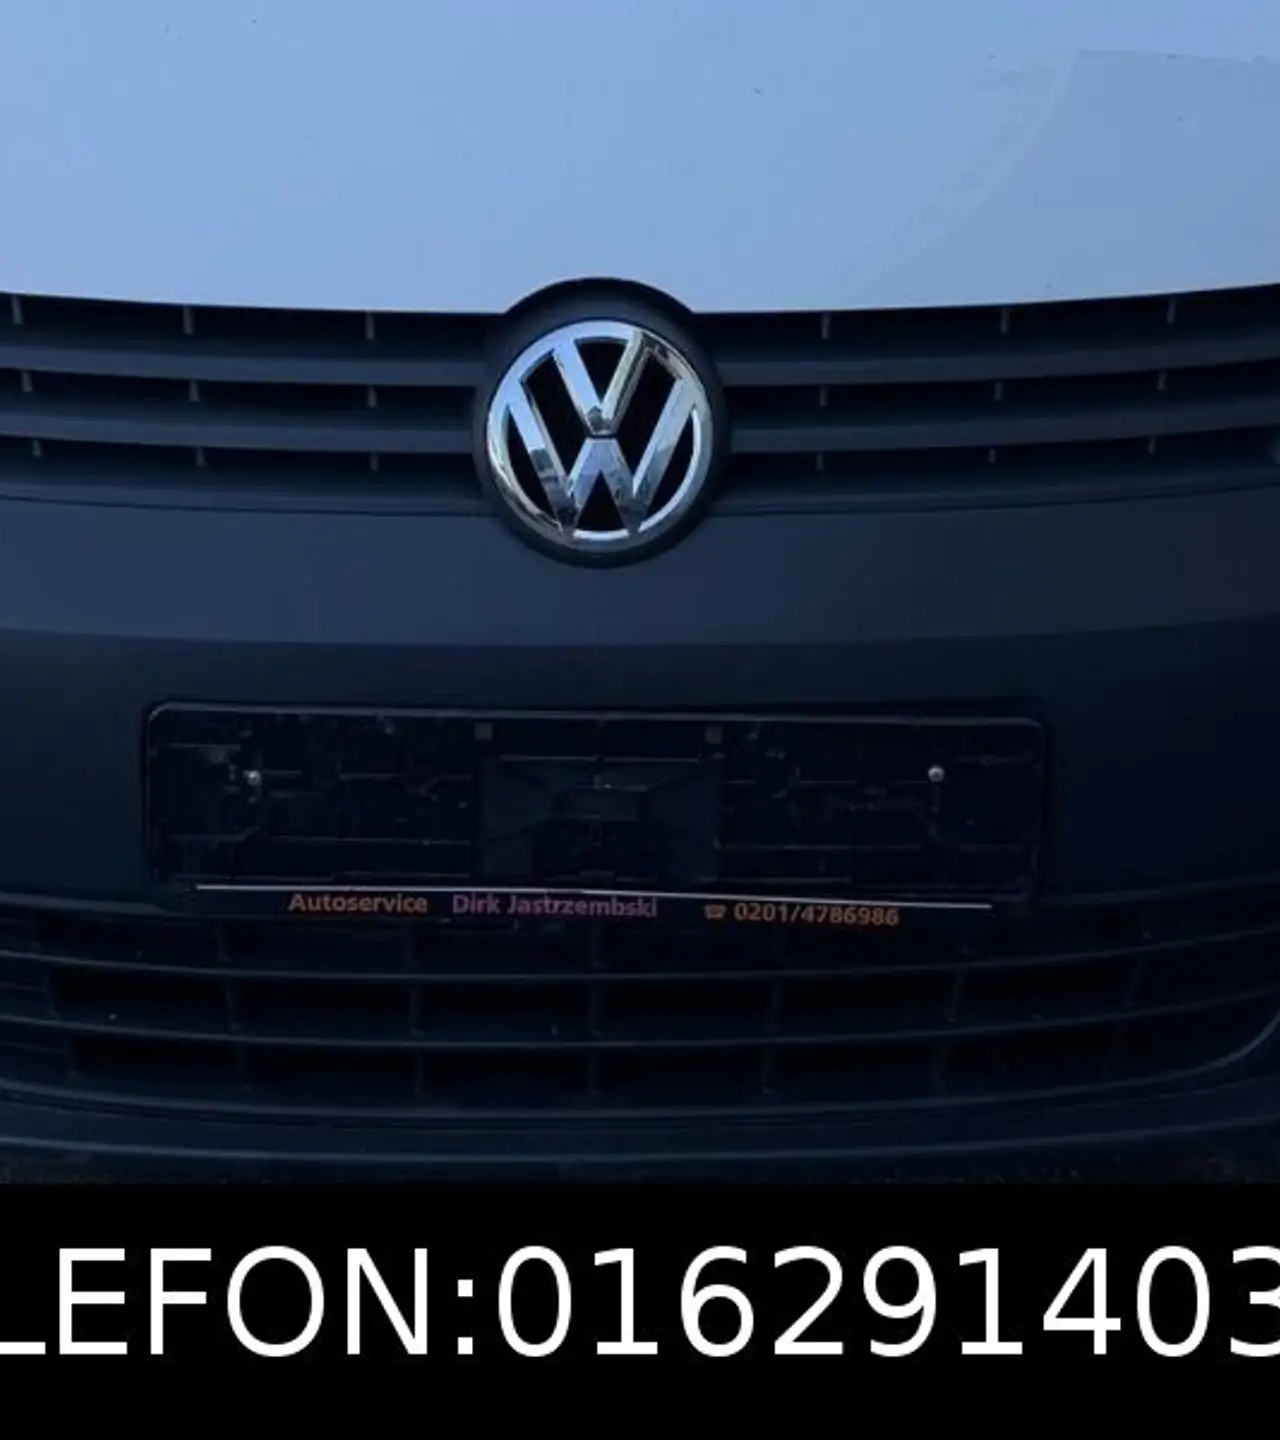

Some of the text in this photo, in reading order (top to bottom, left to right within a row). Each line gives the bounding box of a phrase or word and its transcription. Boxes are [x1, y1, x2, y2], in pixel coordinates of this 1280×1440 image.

[287, 892, 900, 927] Autoservice Dirk Jastrzembski 0201/4786986
